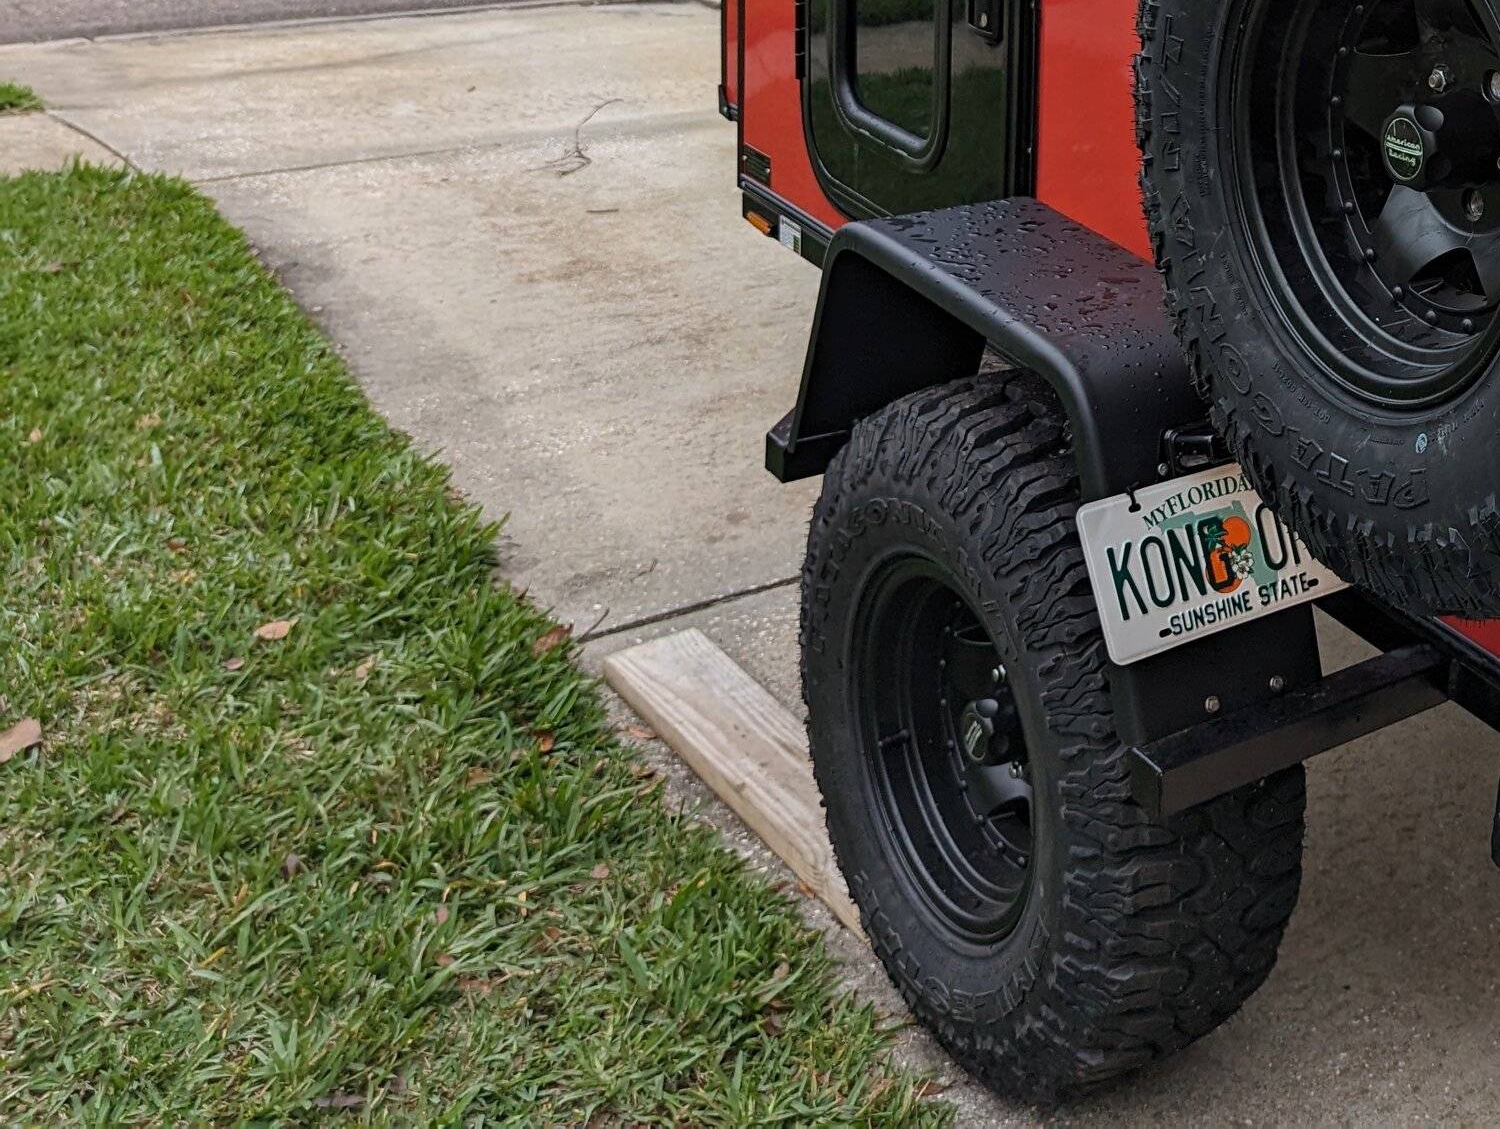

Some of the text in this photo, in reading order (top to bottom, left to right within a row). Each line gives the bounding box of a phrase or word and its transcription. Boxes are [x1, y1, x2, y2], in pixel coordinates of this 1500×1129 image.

[1107, 515, 1236, 622] KONG
[1170, 571, 1310, 636] SUNSHINE STATE
